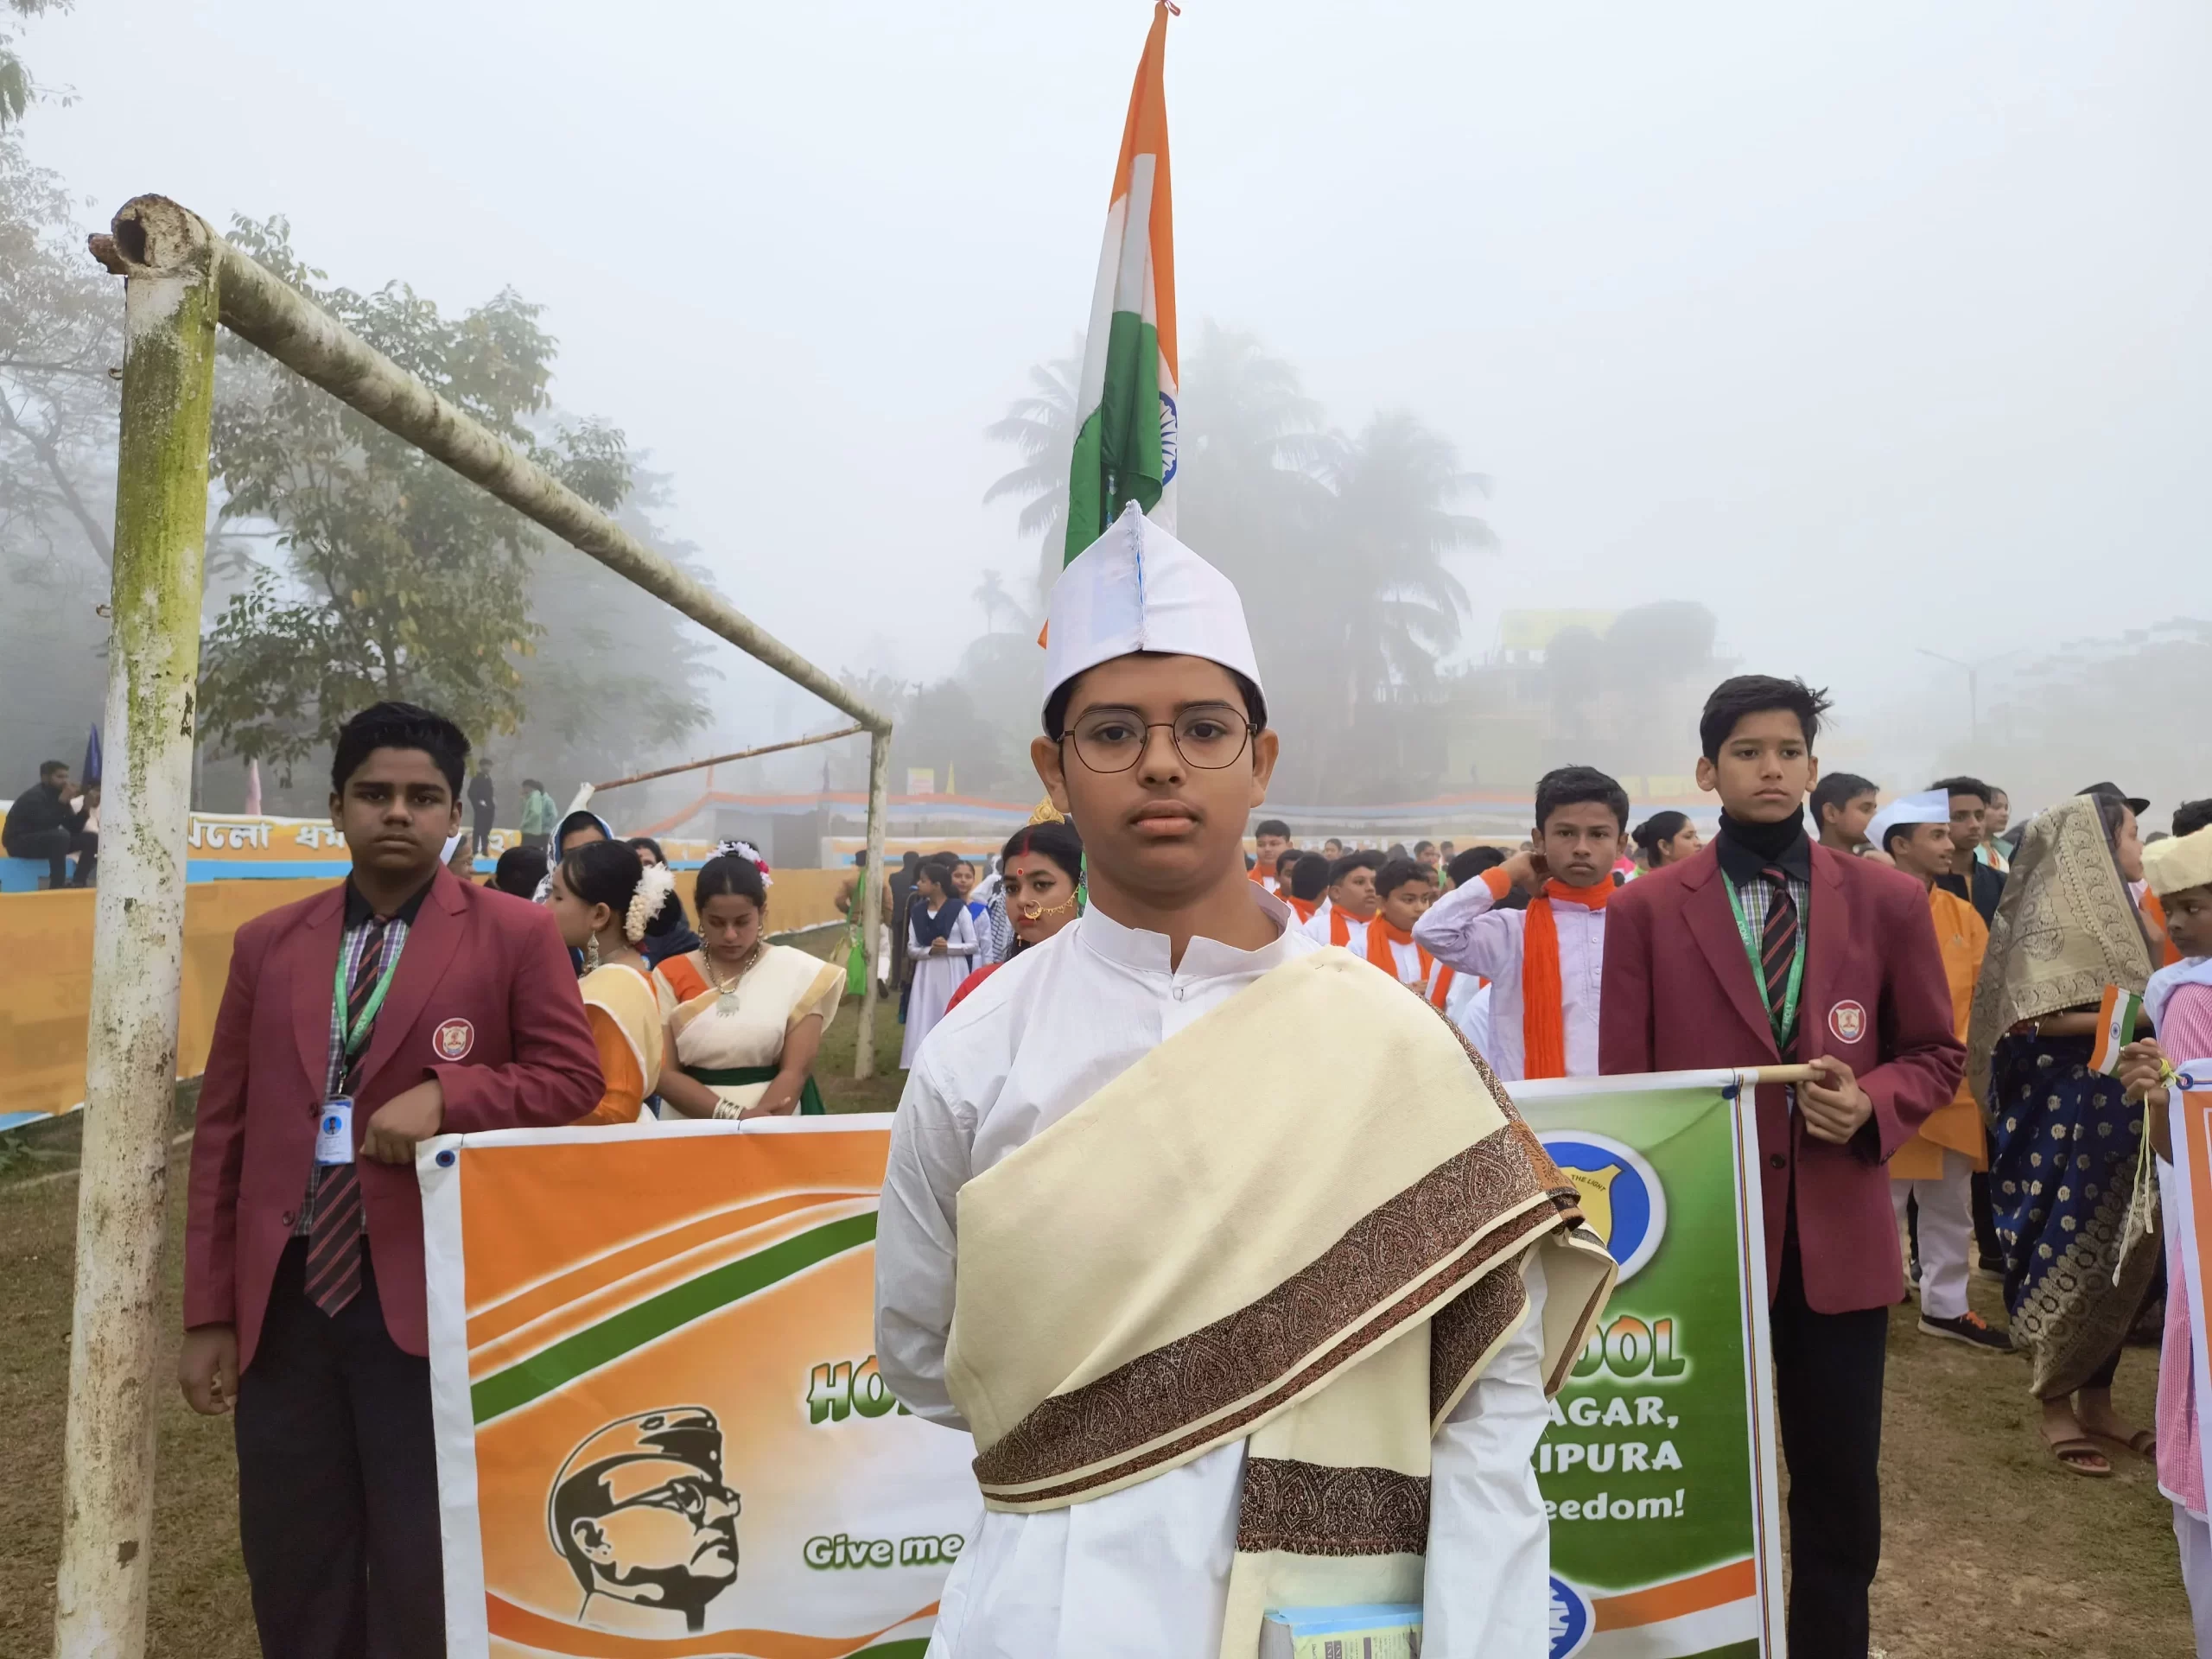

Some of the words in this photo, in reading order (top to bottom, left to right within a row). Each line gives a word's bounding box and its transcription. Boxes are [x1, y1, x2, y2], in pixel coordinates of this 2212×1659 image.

[1736, 920, 1750, 940] HOLY
[1783, 1002, 1794, 1024] HOLY
[1570, 1173, 1586, 1183] THE
[1586, 1179, 1606, 1192] LIGHT
[806, 1355, 912, 1425] HO
[1570, 1314, 1686, 1378] OOL
[1548, 1396, 1679, 1429] AGAR,
[1530, 1440, 1683, 1474] IPURA
[804, 1533, 893, 1571] Give
[899, 1534, 965, 1567] me
[1543, 1489, 1685, 1521] eedom!
